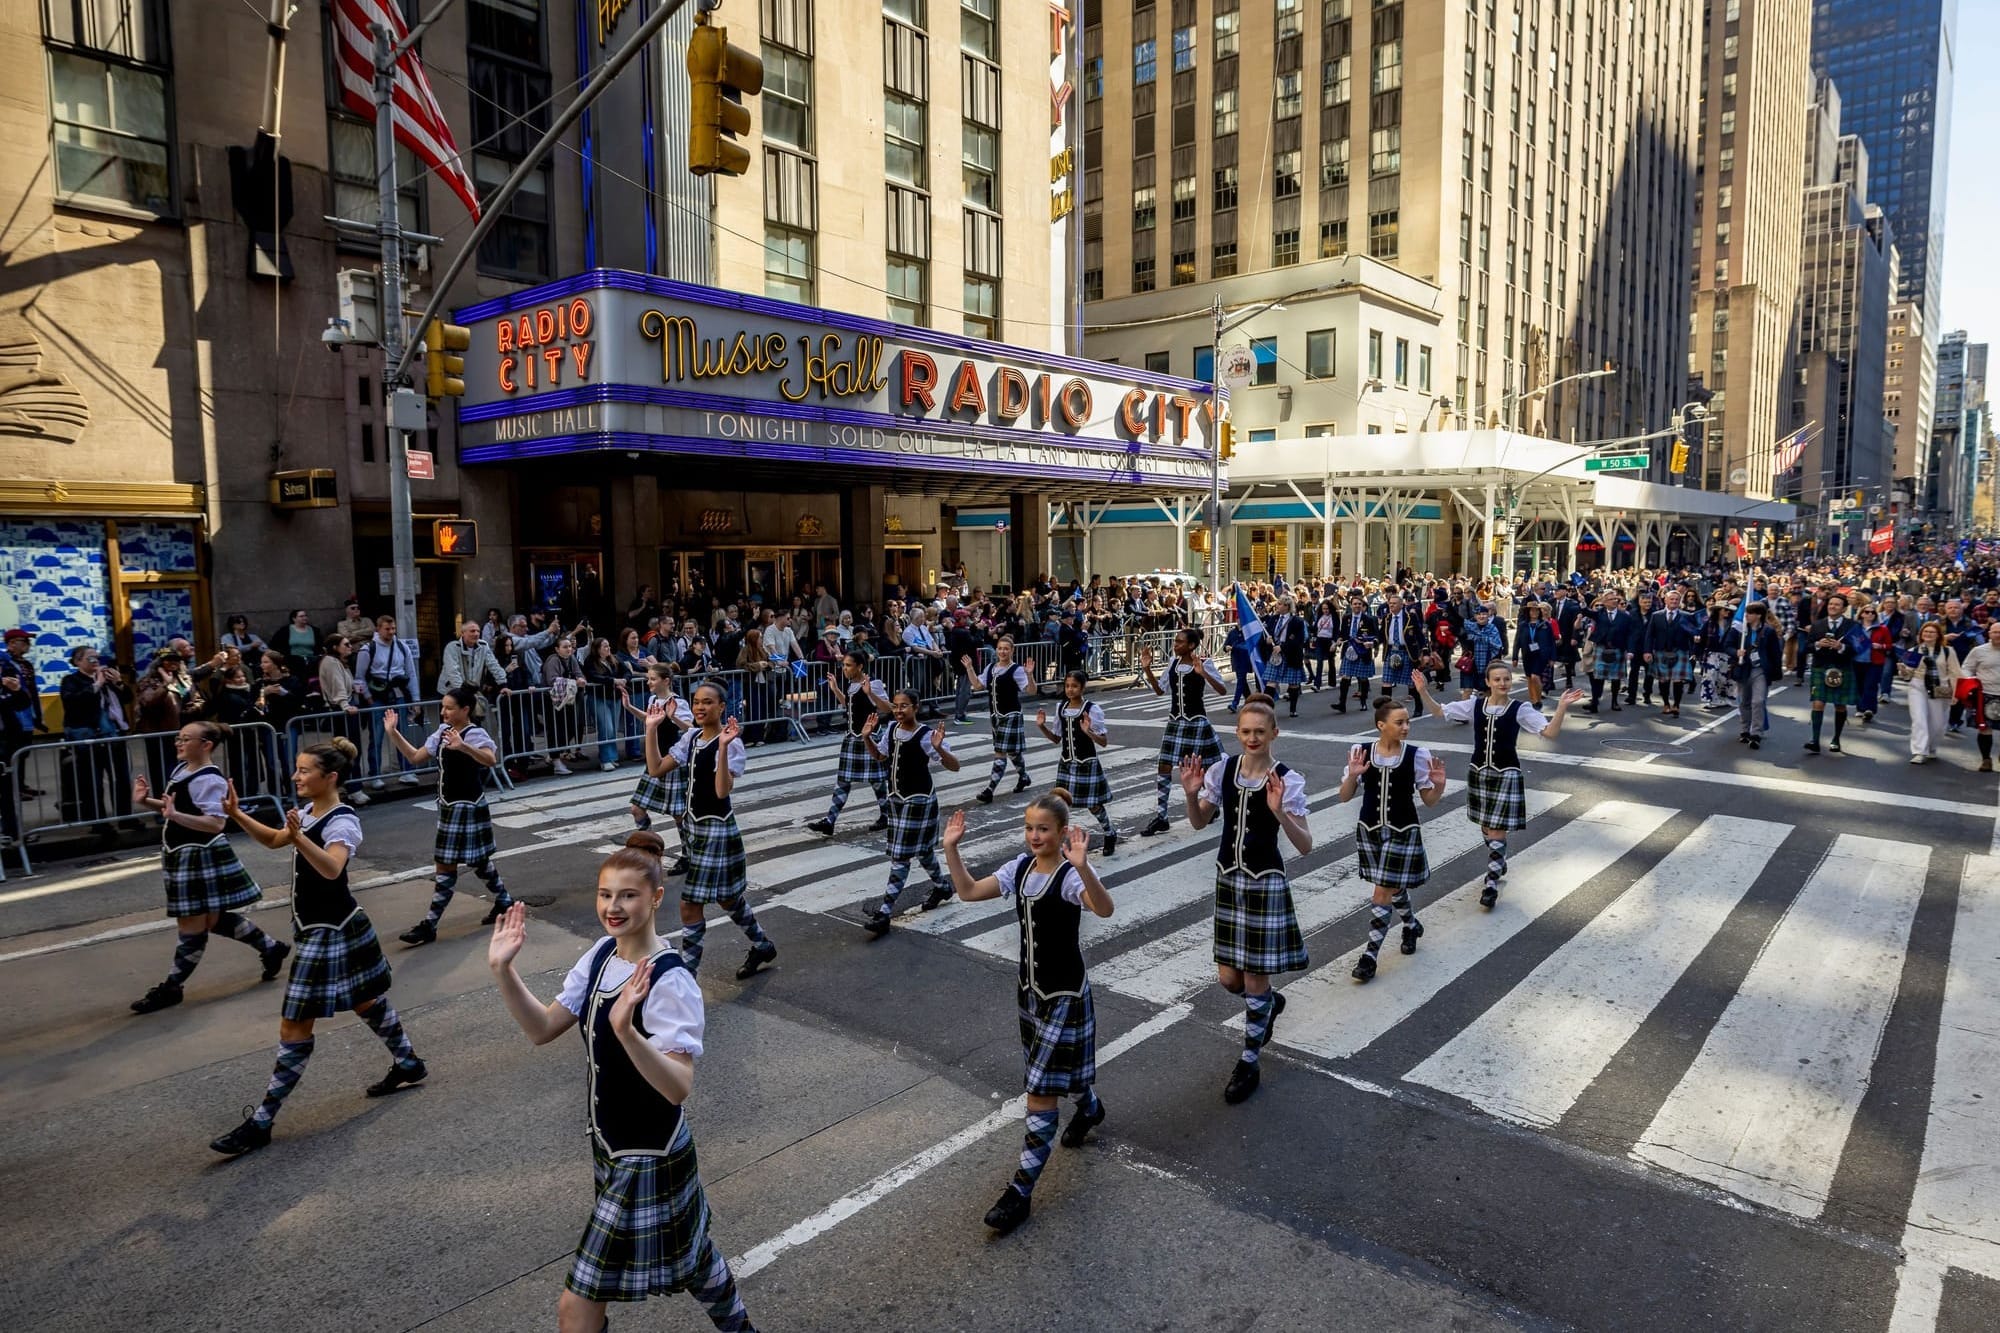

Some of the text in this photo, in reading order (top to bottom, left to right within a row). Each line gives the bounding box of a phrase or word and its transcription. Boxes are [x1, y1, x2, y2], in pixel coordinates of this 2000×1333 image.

[497, 298, 592, 354] RADIO
[498, 340, 592, 394] CITY
[640, 309, 888, 400] Music Hall
[495, 405, 597, 441] MUSIC HALL
[901, 349, 1225, 441] RADIO CITY
[702, 412, 809, 443] TONIGHT
[828, 424, 885, 449] SOLD
[899, 431, 937, 454] OUT
[962, 437, 984, 459] LA
[996, 440, 1017, 462] LA
[1028, 442, 1068, 466] LAND
[1078, 449, 1090, 467] IN
[1100, 451, 1160, 473] CONCERT
[1601, 458, 1631, 468] W 50 St
